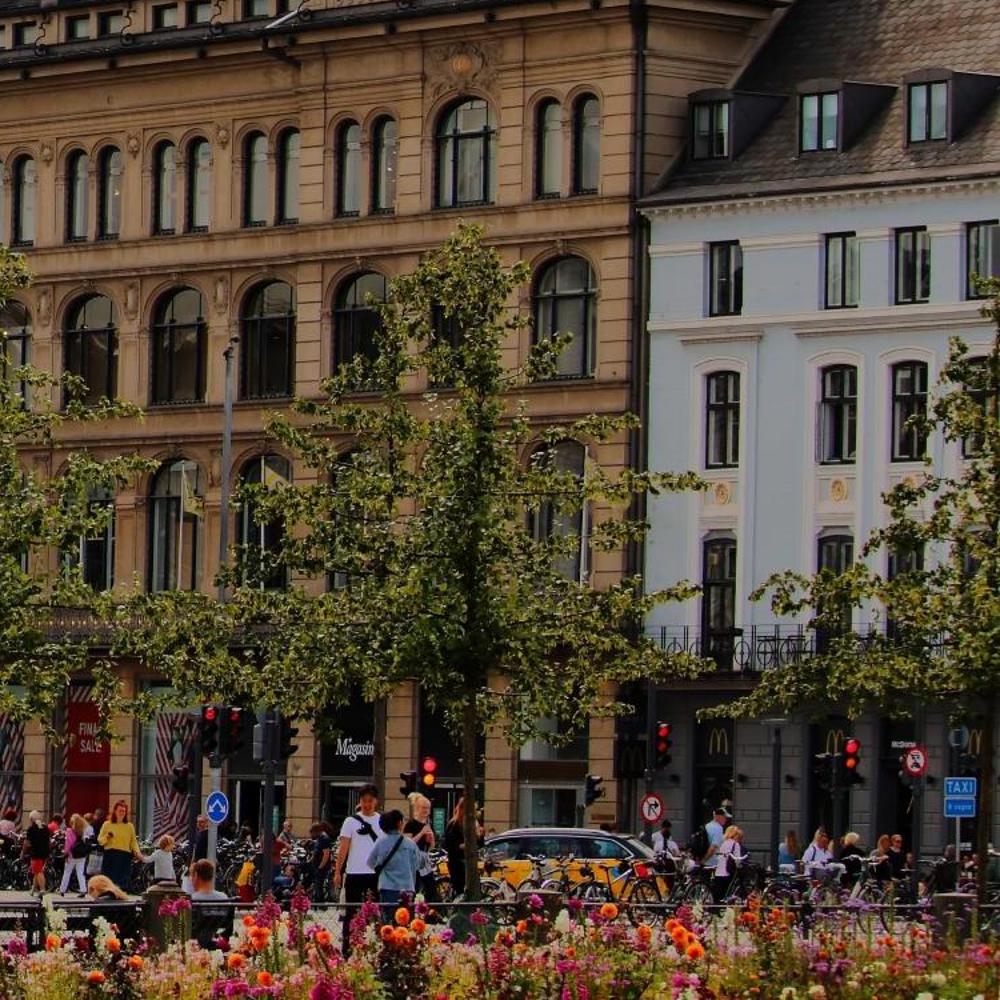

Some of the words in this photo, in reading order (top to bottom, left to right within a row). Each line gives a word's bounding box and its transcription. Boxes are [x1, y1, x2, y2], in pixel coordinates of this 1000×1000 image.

[79, 722, 99, 737] FINA
[336, 738, 374, 762] Magasin
[946, 780, 973, 793] TAXI
